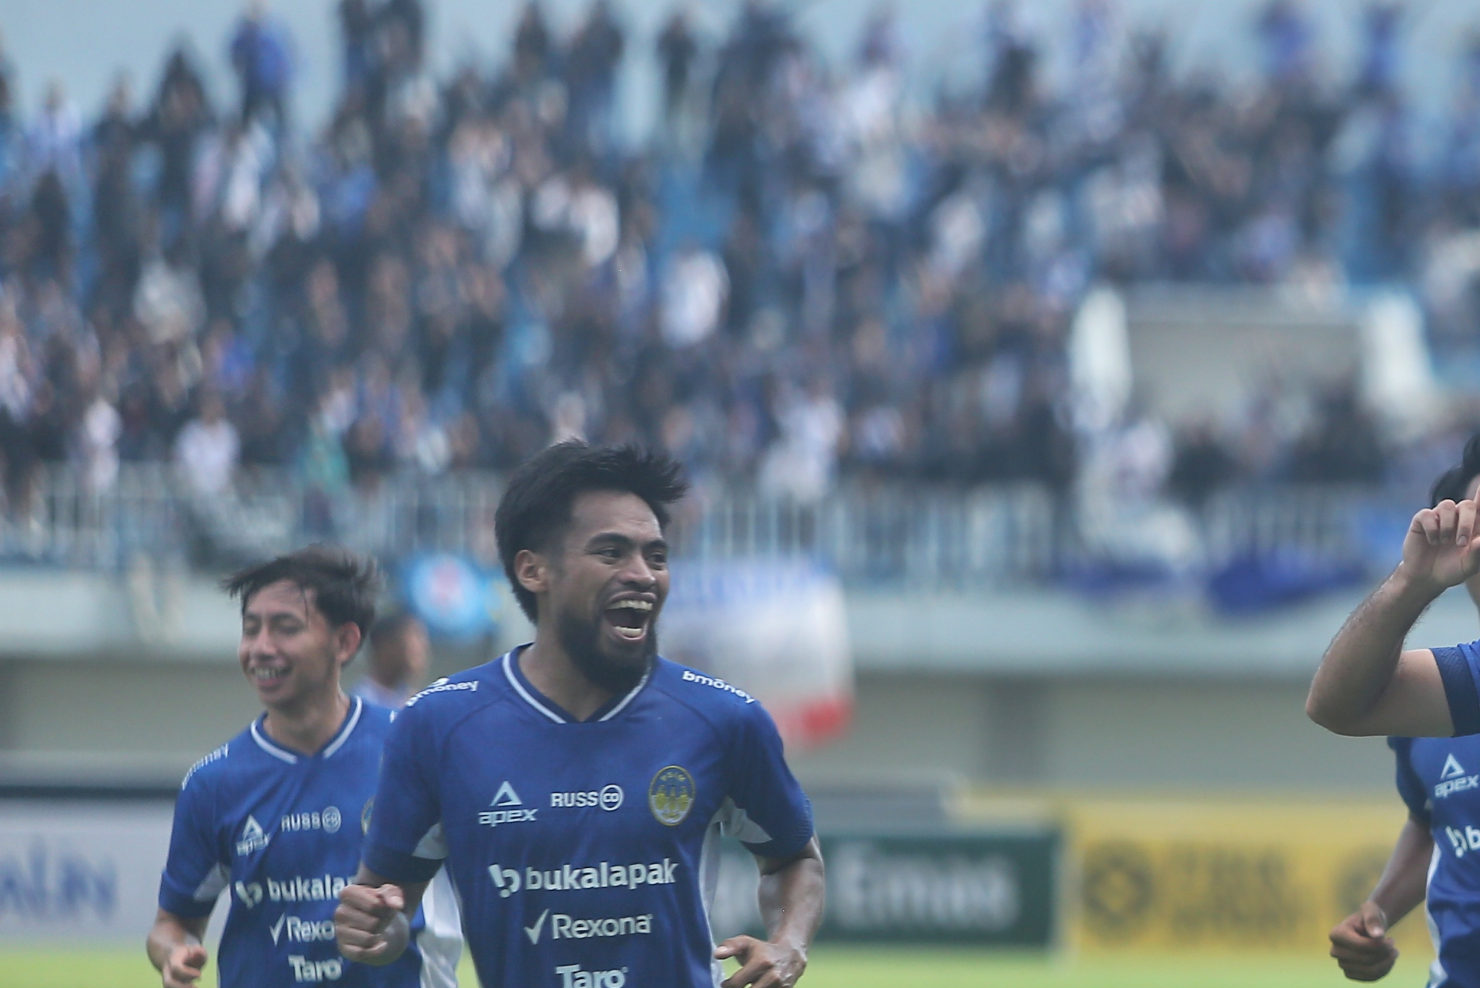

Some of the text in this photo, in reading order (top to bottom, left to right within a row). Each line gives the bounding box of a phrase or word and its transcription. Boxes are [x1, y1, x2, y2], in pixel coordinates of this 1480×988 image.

[682, 669, 755, 703] bmoney
[1434, 774, 1480, 799] apex
[478, 808, 539, 827] apex
[525, 858, 680, 890] bukalapak
[552, 913, 652, 940] Rexona
[288, 955, 343, 983] Taro
